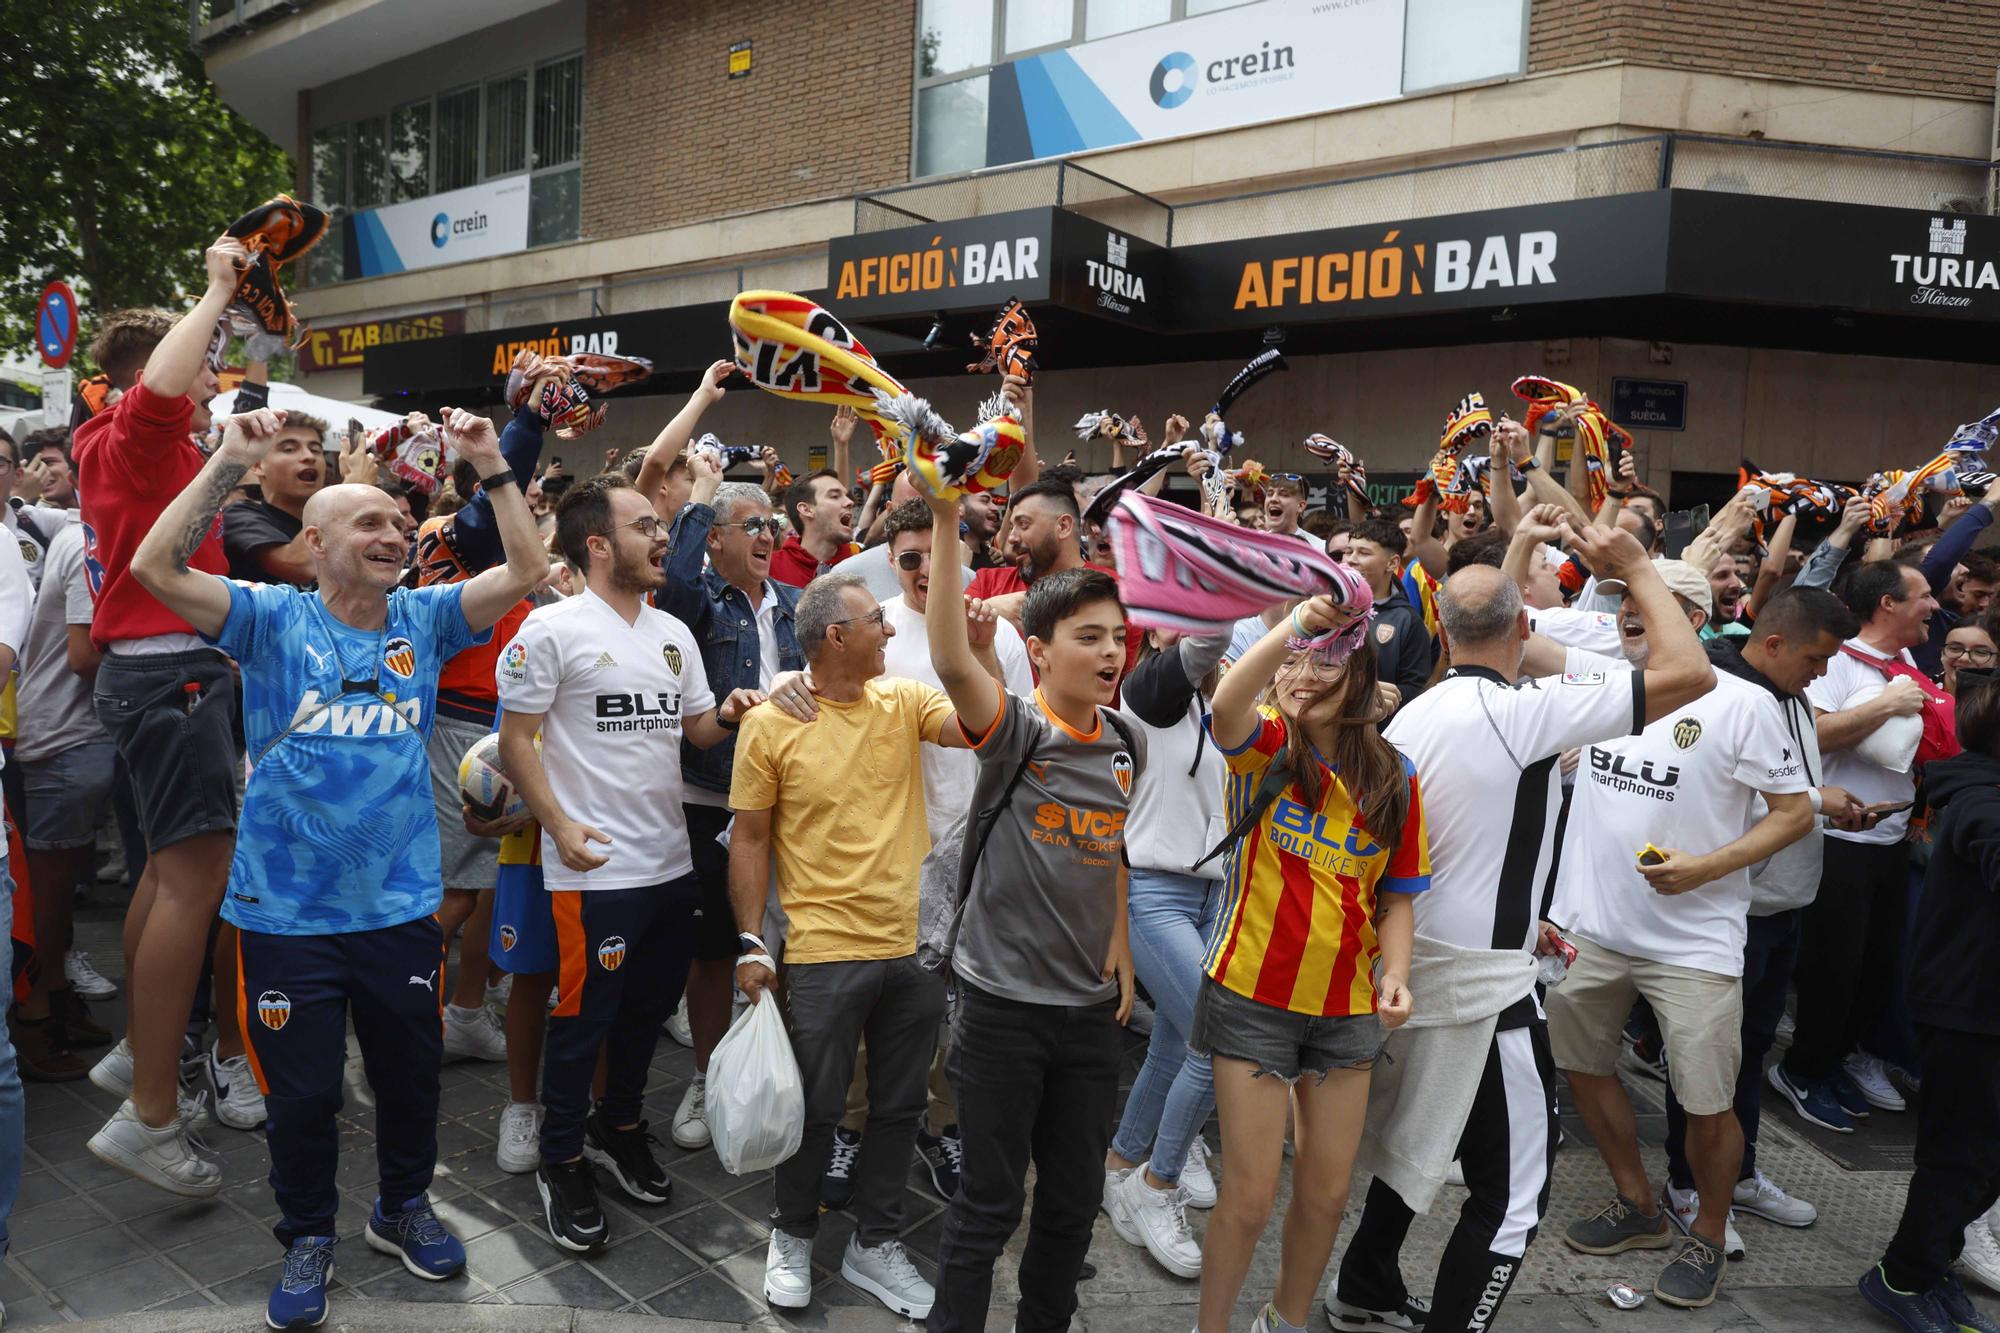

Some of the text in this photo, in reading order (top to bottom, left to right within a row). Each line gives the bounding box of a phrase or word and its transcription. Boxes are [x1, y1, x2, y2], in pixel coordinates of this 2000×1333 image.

[1206, 41, 1295, 83] crein
[452, 210, 488, 234] crein
[836, 235, 1040, 300] AFICIÓN BAR
[1085, 259, 1146, 303] TURIA
[1233, 230, 1558, 311] AFICIÓN BAR
[1890, 254, 2000, 290] TURIA
[1910, 286, 1974, 307] Märzen
[338, 316, 444, 352] TABACOS
[571, 331, 619, 355] BAR
[1247, 348, 1281, 371] STADIUM
[1644, 399, 1656, 409] DE
[502, 668, 524, 680] LaLiga
[288, 690, 421, 737] bwin
[596, 715, 680, 733] smartphone
[1591, 769, 1676, 802] martphones
[1031, 828, 1070, 847] FAN
[1271, 798, 1381, 857] BLU
